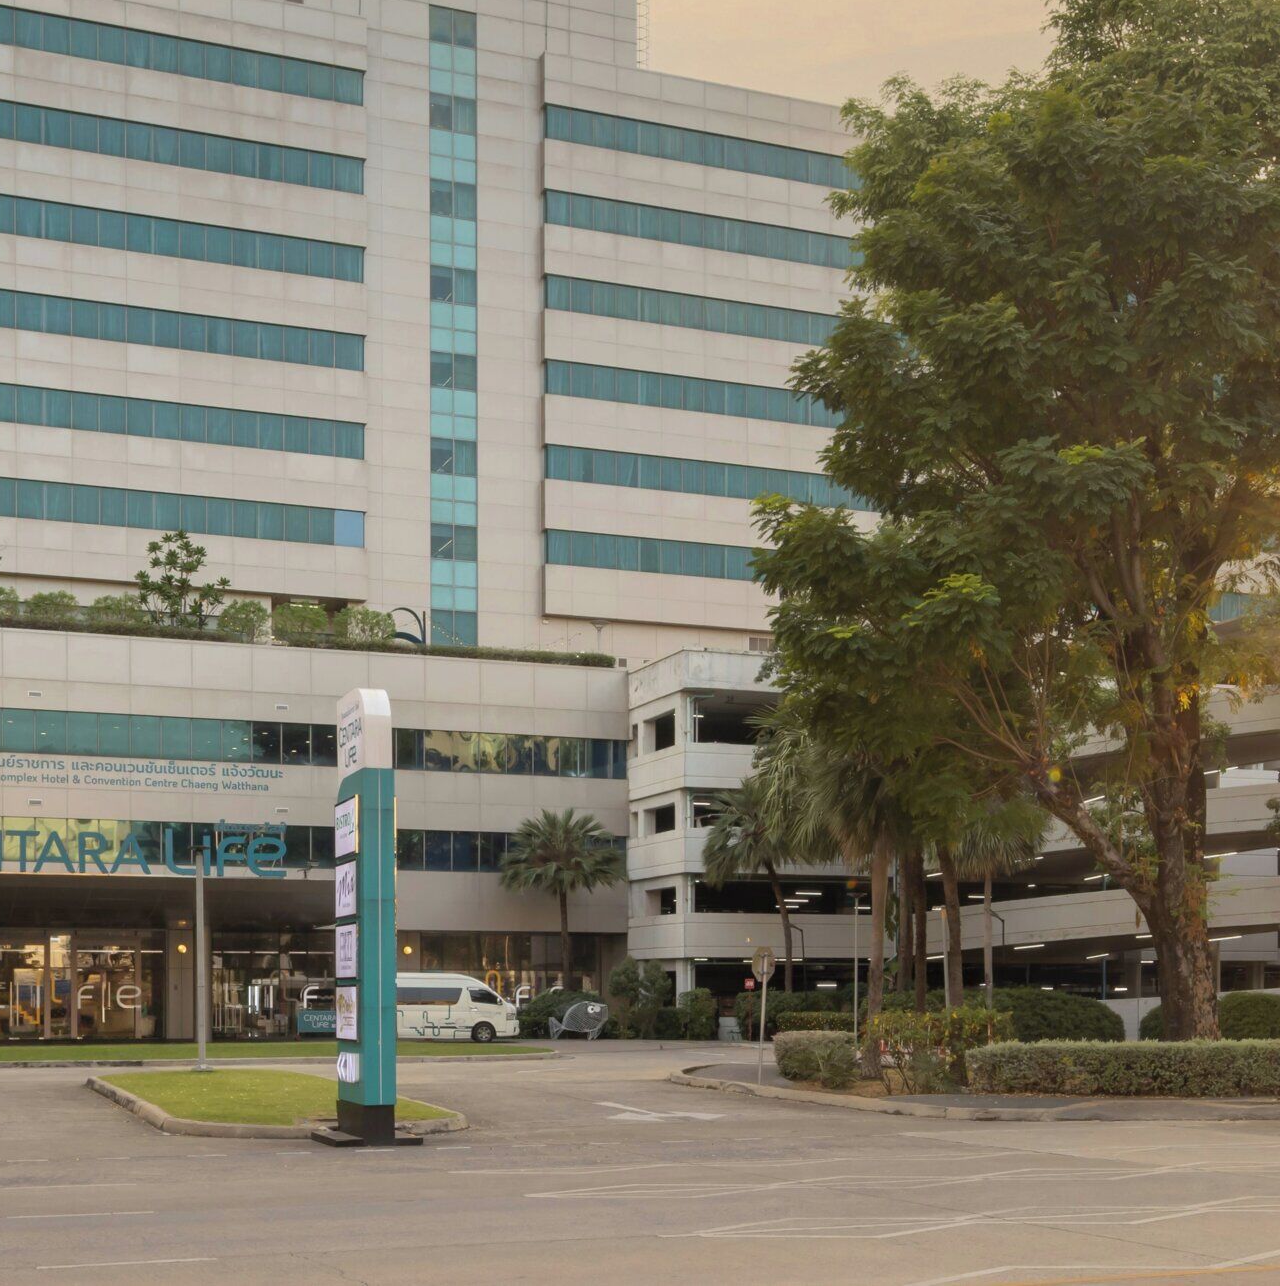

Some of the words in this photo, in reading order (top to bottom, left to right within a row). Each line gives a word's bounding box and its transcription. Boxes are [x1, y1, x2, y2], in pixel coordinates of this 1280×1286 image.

[222, 764, 284, 779] แจ้งวัฒนะ
[41, 774, 69, 785] Hotel
[72, 775, 81, 785] &
[84, 775, 141, 787] Convention
[144, 776, 178, 789] Centre
[181, 777, 219, 792] Chaeng
[222, 780, 269, 792] Watthana
[303, 1014, 336, 1022] CENTARA
